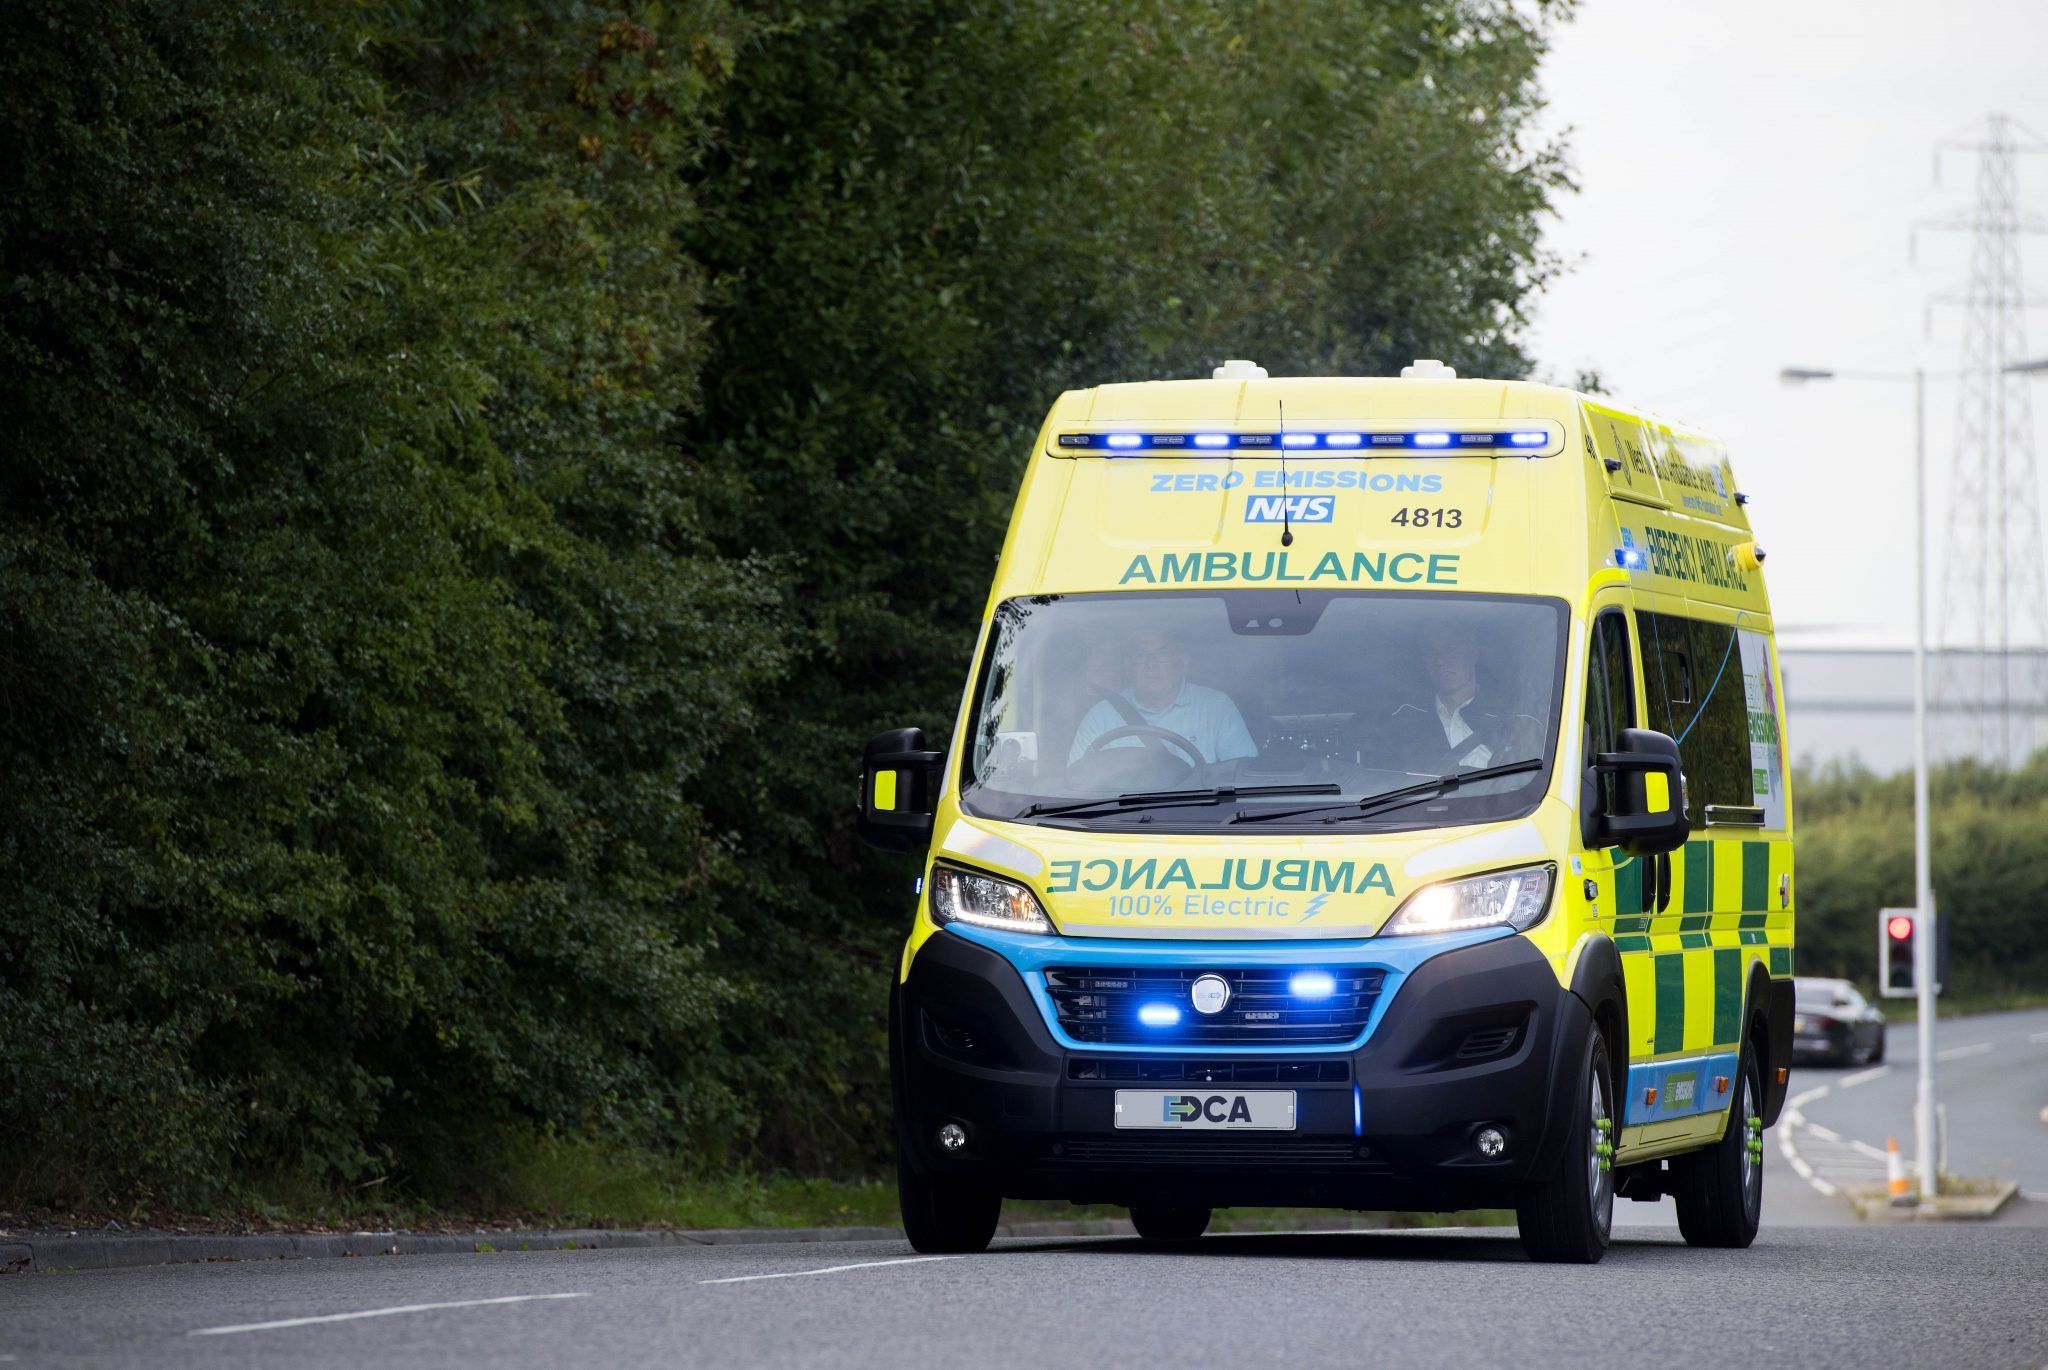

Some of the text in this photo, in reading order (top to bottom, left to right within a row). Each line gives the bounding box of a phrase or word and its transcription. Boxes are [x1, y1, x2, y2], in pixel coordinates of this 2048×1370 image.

[1150, 470, 1443, 493] ZERO EMISSIONS
[1249, 497, 1334, 522] NHS
[1390, 507, 1463, 529] 4813
[1644, 525, 1700, 583] EMERGENCY
[1118, 551, 1461, 585] AMBULANCE
[1109, 894, 1290, 918] 100% Electric
[1163, 1095, 1253, 1123] EDCA
